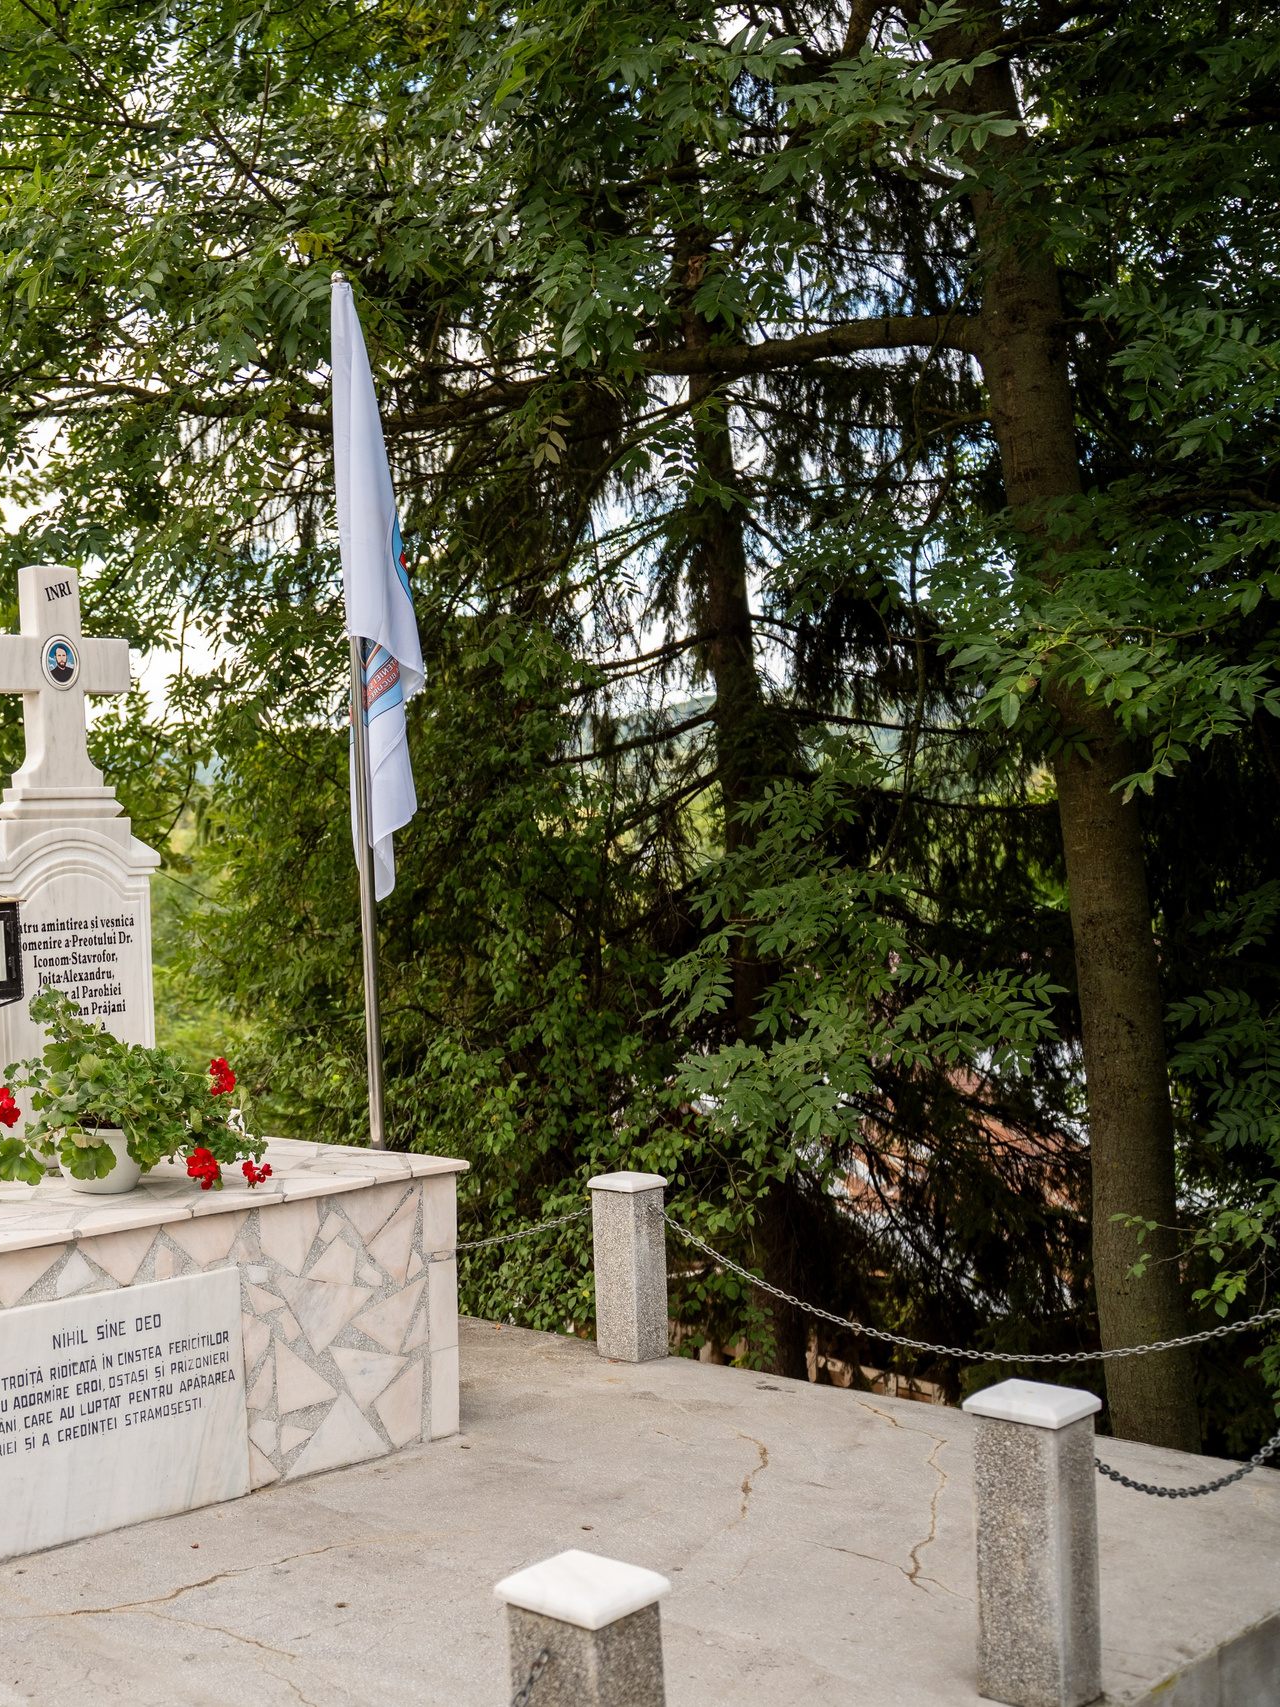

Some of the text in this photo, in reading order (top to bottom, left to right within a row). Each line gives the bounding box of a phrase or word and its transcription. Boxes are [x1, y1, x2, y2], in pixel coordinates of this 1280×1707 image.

[45, 581, 72, 602] INRI
[41, 918, 89, 932] amintirea
[22, 936, 63, 952] omenire
[118, 931, 133, 945] Dr.
[71, 986, 80, 999] al
[82, 983, 122, 998] Parohiei
[135, 1313, 161, 1332] DEO
[23, 1411, 53, 1429] CARE
[60, 1405, 75, 1421] AU
[80, 1394, 121, 1416] LUPTAT
[128, 1383, 173, 1404] PENTRU
[41, 1433, 51, 1447] A
